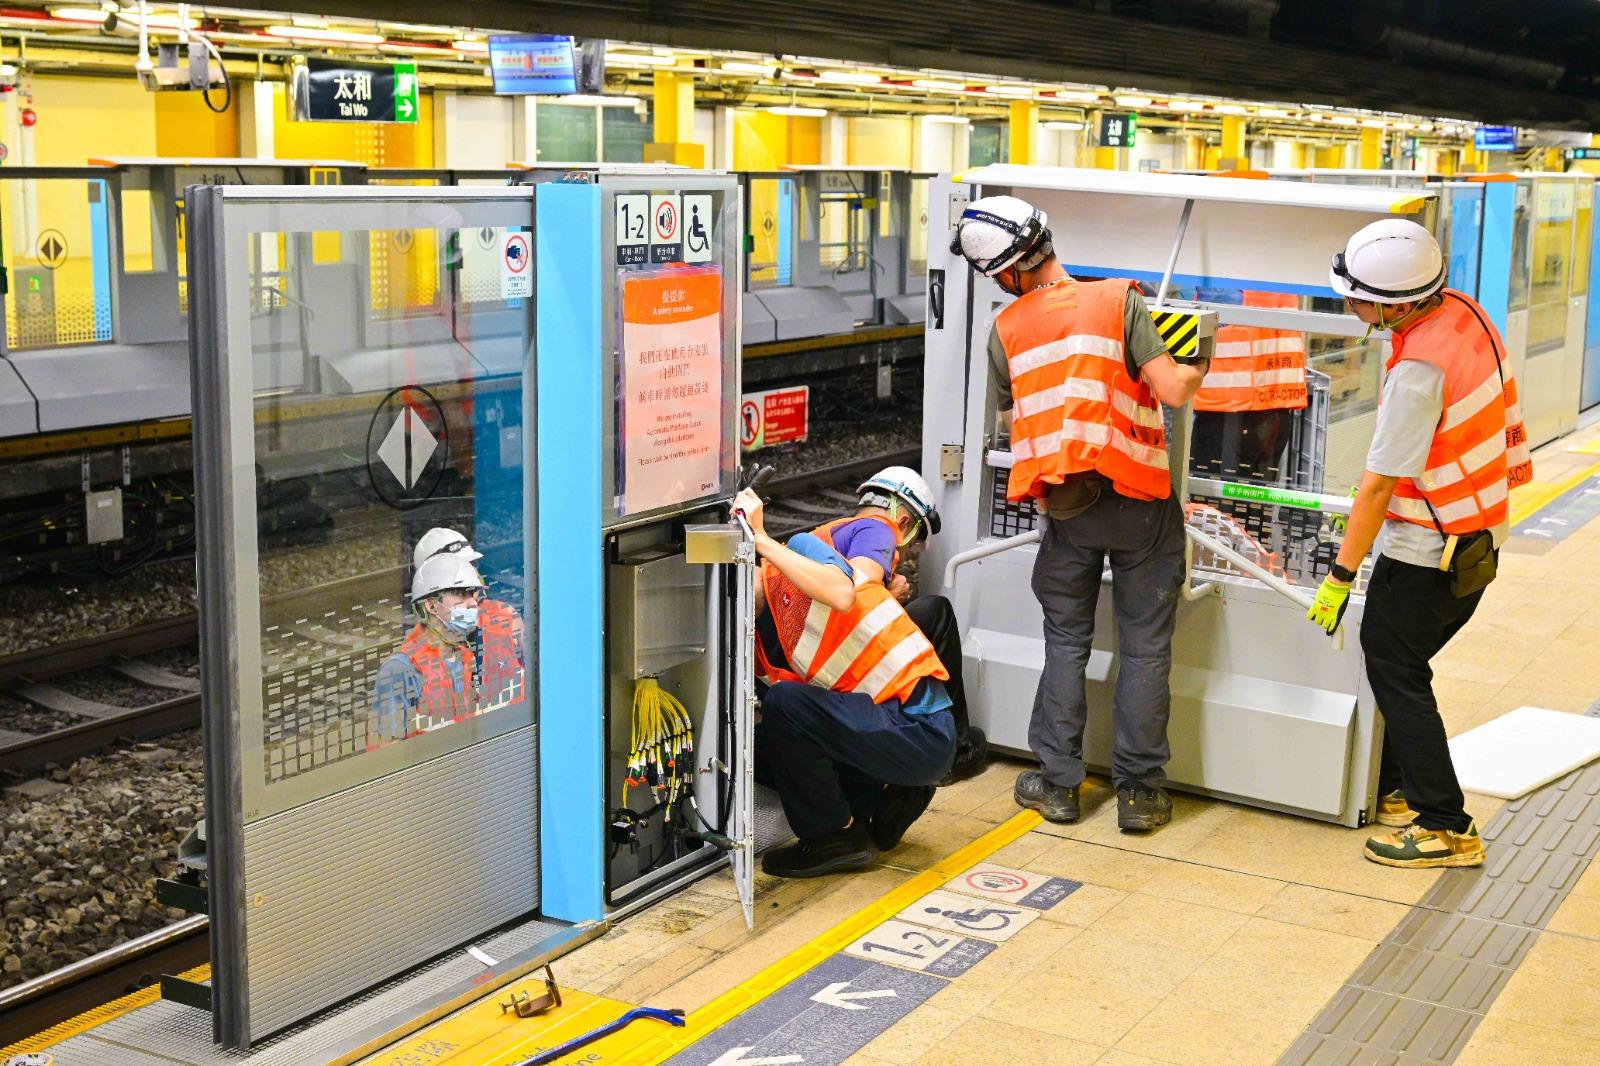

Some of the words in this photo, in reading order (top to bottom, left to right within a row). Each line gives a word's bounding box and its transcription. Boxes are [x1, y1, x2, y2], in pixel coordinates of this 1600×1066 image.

[333, 71, 372, 101] 太和
[339, 103, 353, 117] Tai
[353, 103, 369, 117] Wo
[621, 203, 645, 240] 1-2
[862, 931, 950, 960] 1-2
